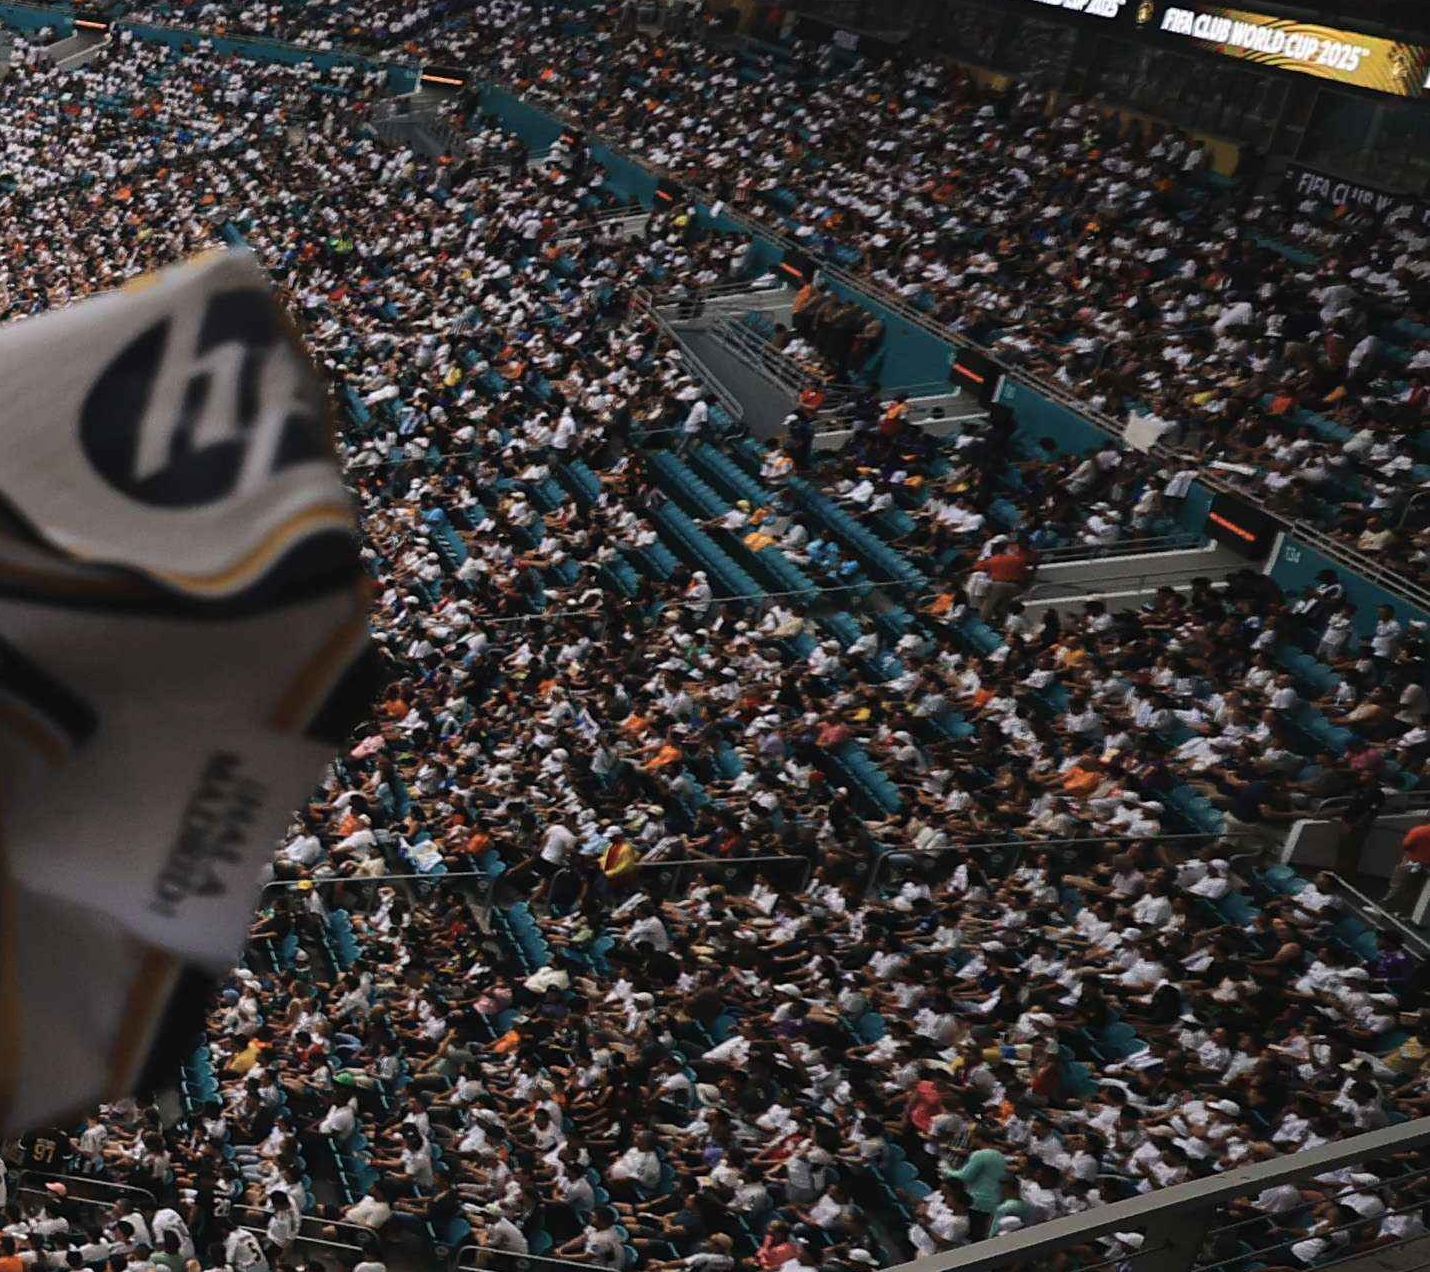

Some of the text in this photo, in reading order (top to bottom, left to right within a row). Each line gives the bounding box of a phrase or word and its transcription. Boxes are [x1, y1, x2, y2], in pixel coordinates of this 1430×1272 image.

[1161, 6, 1194, 35] FIFA
[1195, 12, 1229, 44] CLUB
[1230, 19, 1288, 53] WORLD
[1290, 29, 1320, 62] CUP
